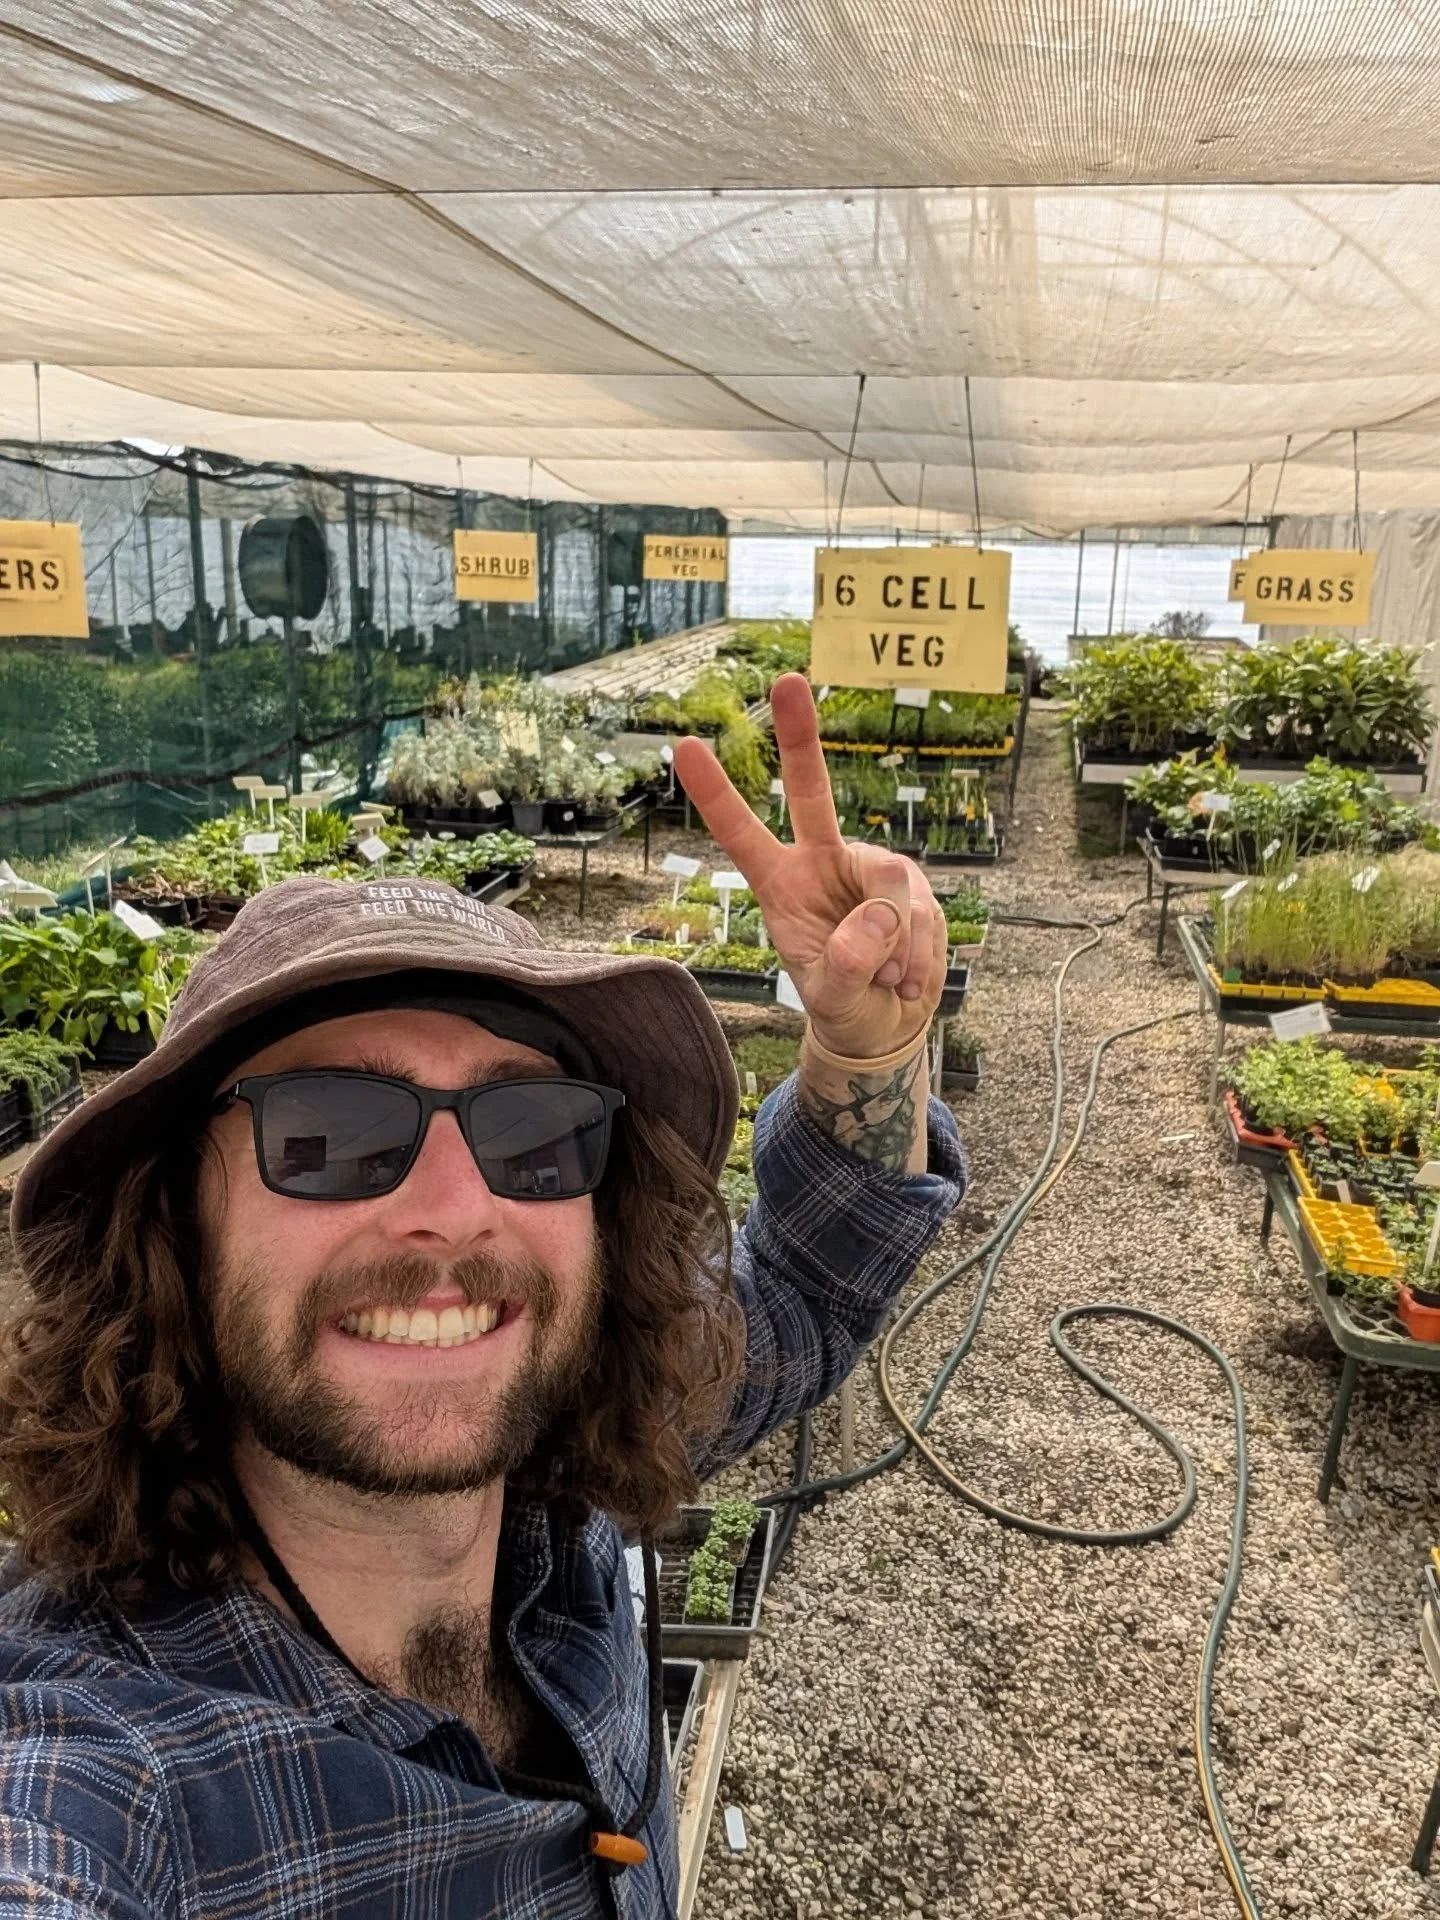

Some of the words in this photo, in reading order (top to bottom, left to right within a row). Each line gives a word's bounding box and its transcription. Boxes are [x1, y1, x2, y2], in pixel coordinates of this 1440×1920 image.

[460, 556, 530, 576] SHRUB
[672, 564, 698, 577] VEG
[818, 572, 856, 607] 16
[882, 575, 985, 611] CELL
[1256, 576, 1354, 603] GRASS
[869, 633, 944, 668] VEG
[368, 886, 414, 899] FEED
[417, 888, 453, 903] THE
[360, 900, 408, 916] FEED
[411, 901, 449, 918] THE
